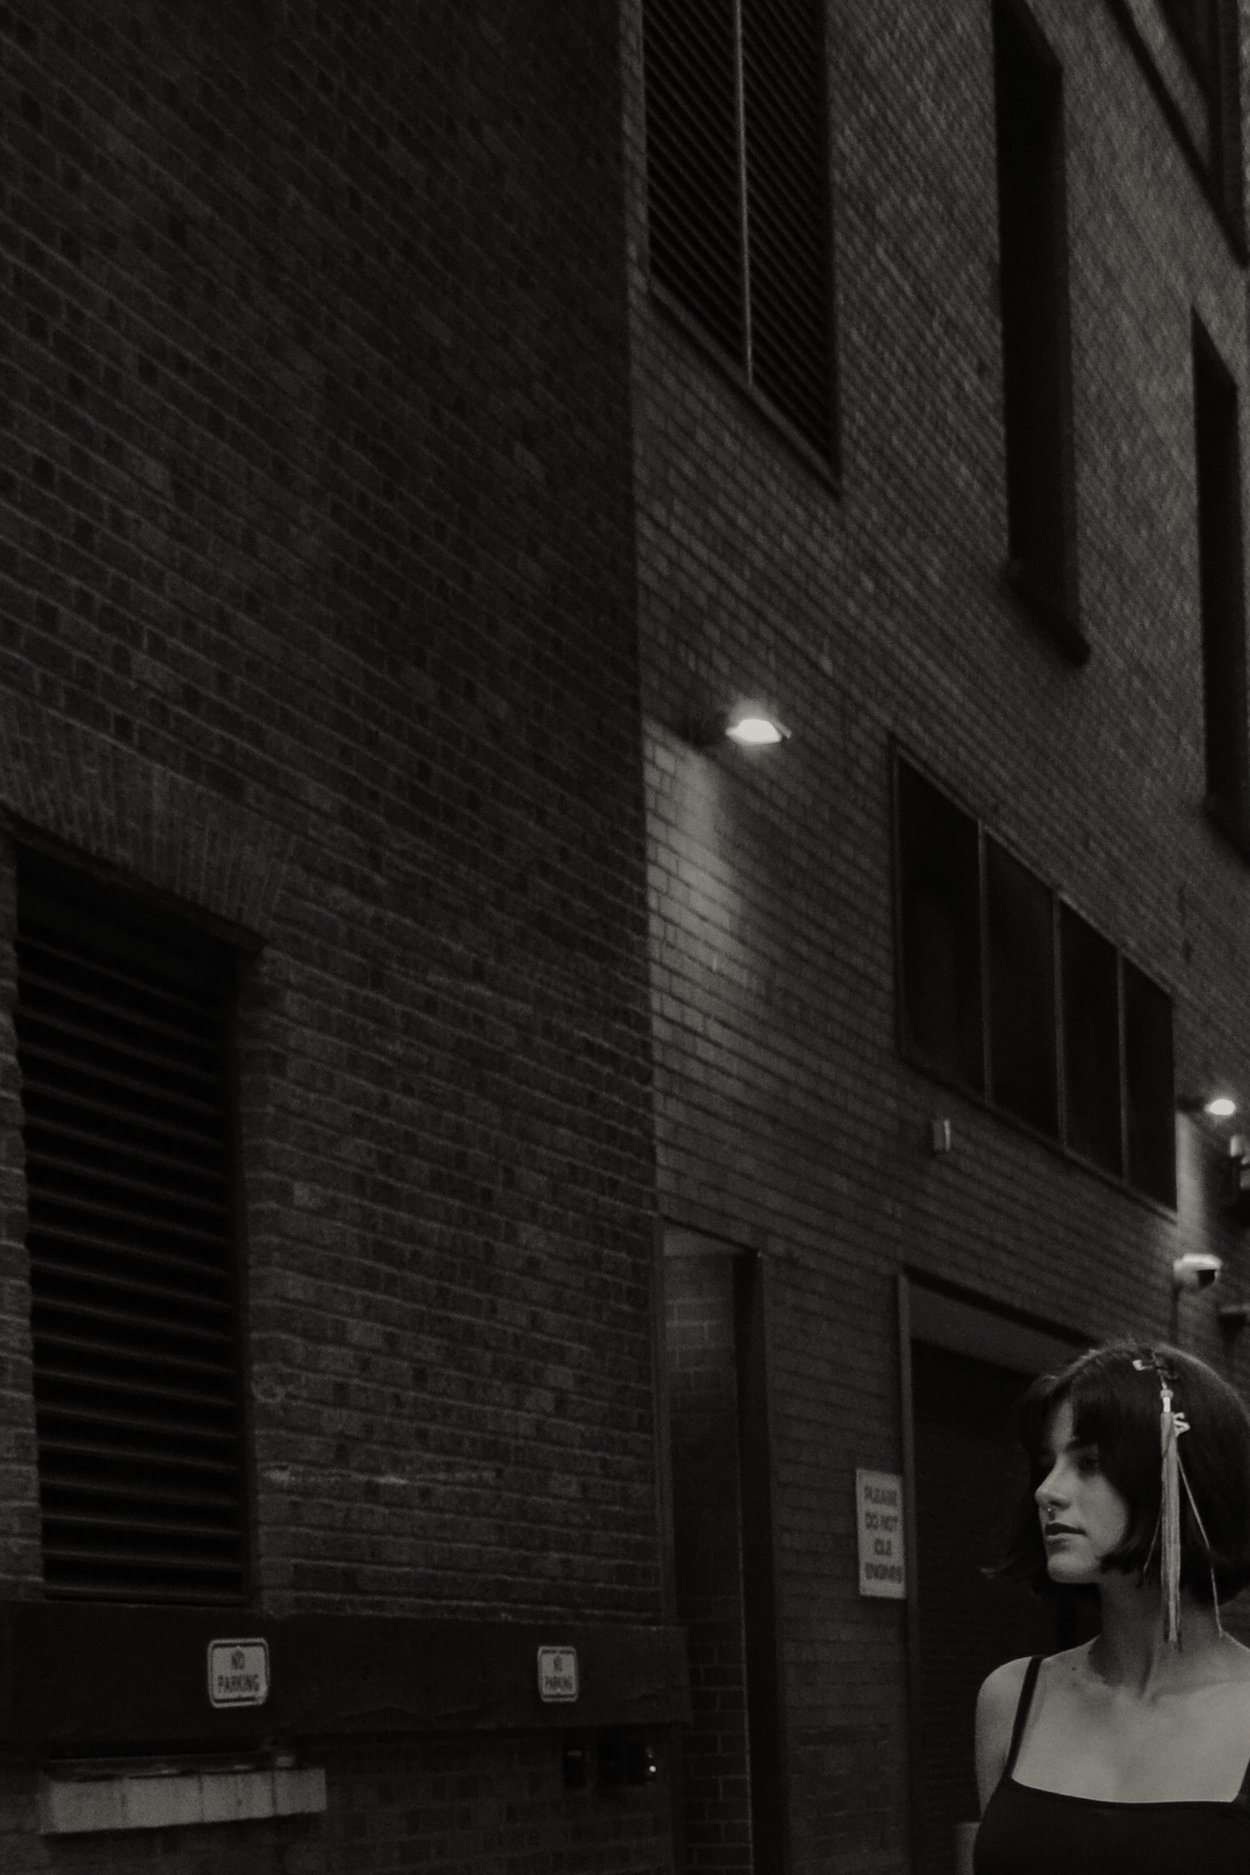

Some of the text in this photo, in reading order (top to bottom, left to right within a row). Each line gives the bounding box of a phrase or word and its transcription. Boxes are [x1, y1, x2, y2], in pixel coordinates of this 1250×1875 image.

[863, 1485, 897, 1506] PLEASE
[864, 1511, 898, 1532] DO NOT
[873, 1537, 892, 1557] IDLE
[231, 1649, 246, 1670] NO
[553, 1655, 563, 1672] NO
[217, 1673, 260, 1694] PARKING
[544, 1675, 573, 1692] PARKING
